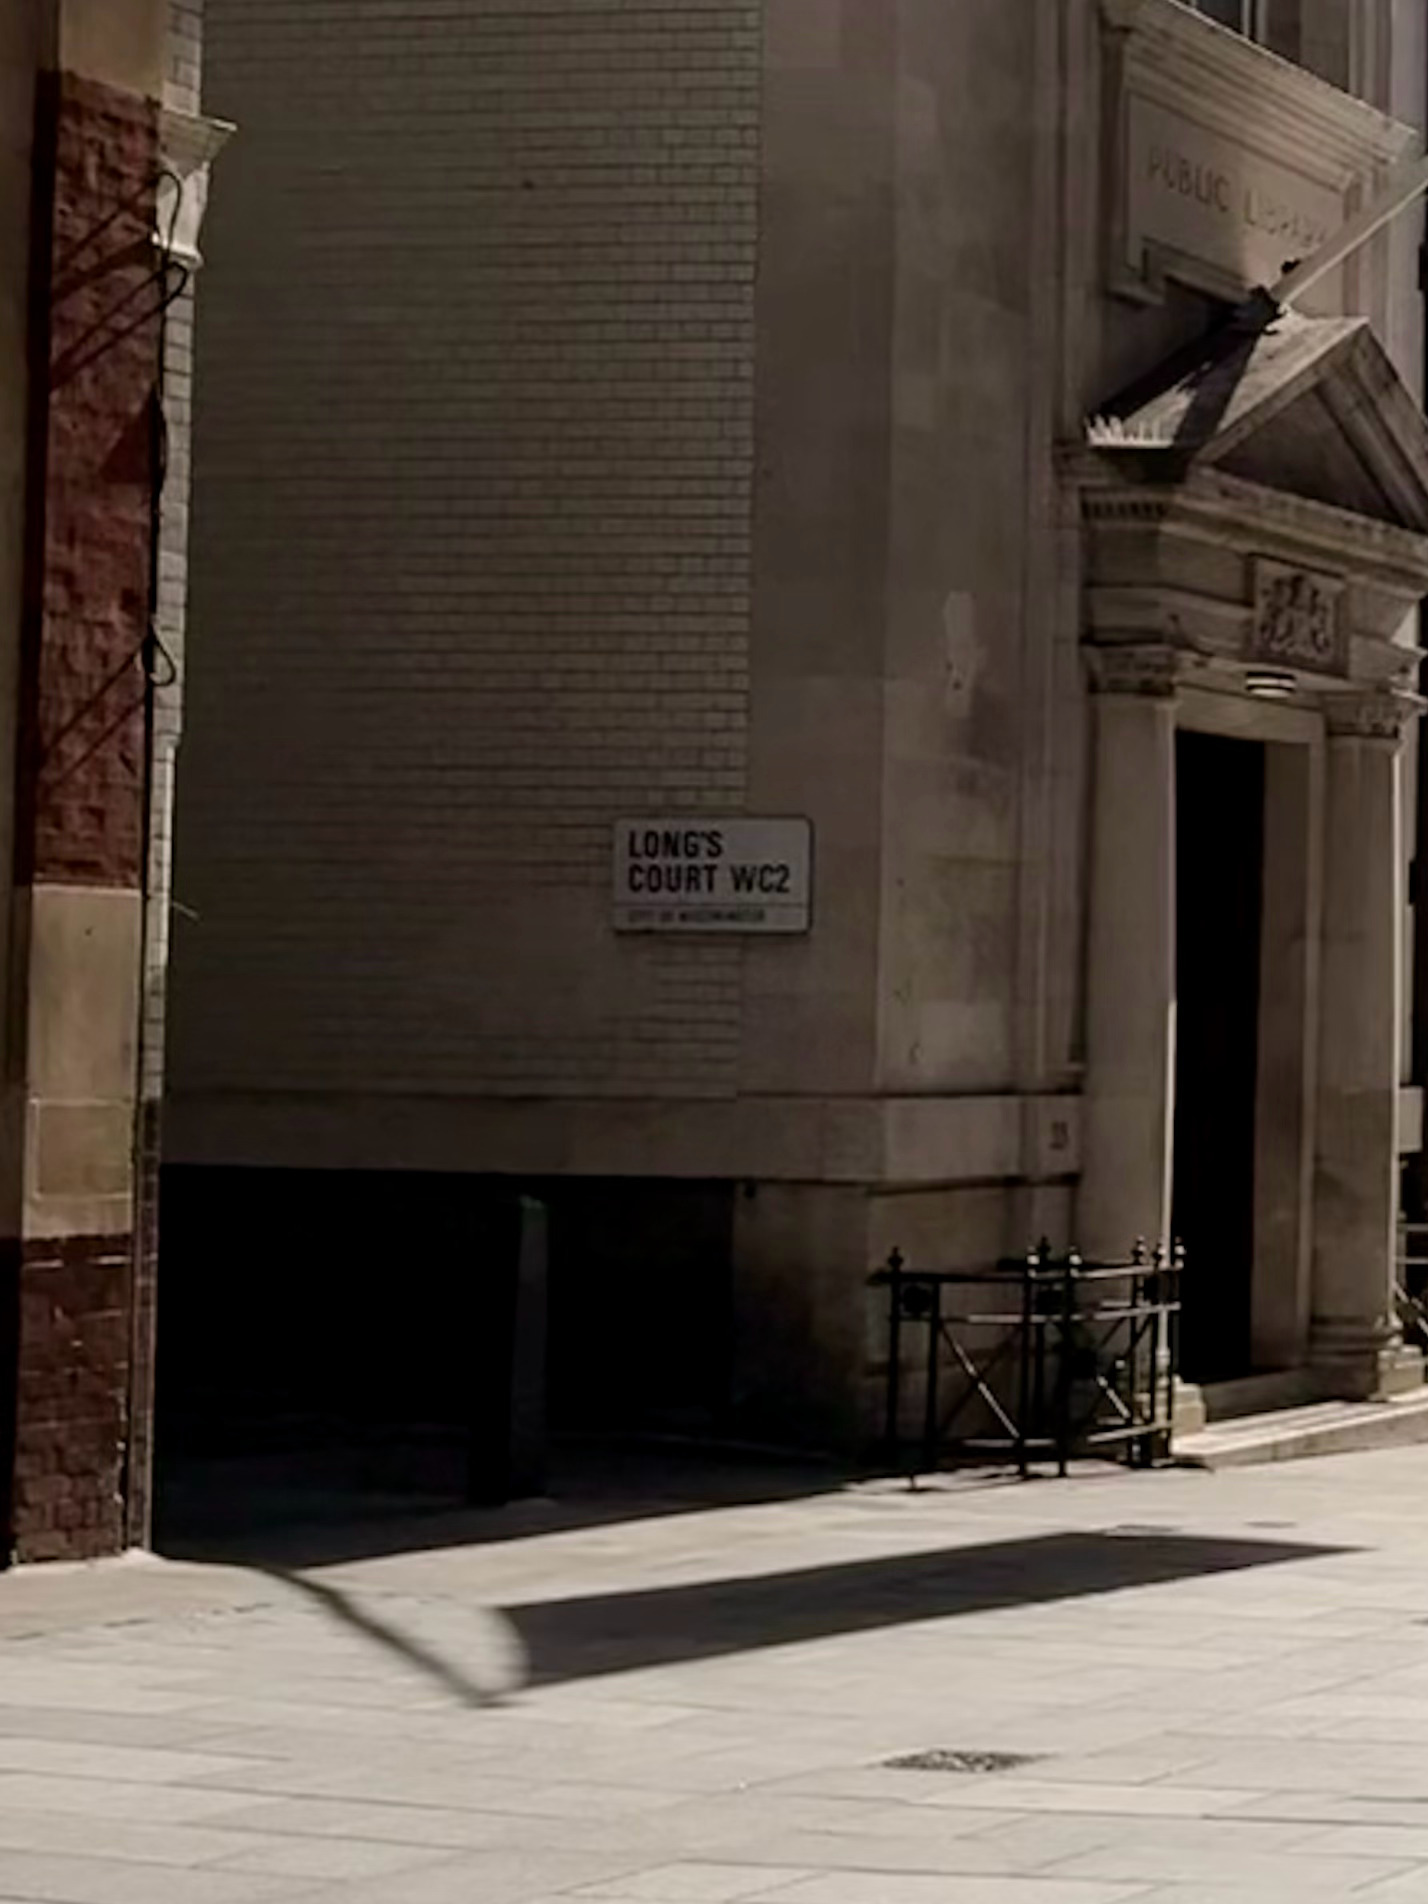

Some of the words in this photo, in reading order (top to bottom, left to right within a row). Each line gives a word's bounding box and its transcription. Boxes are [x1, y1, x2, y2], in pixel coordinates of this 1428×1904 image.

[1148, 145, 1230, 213] PUBLIC
[628, 830, 724, 859] LONG'S
[628, 864, 718, 894] COURT
[730, 864, 791, 894] WC2
